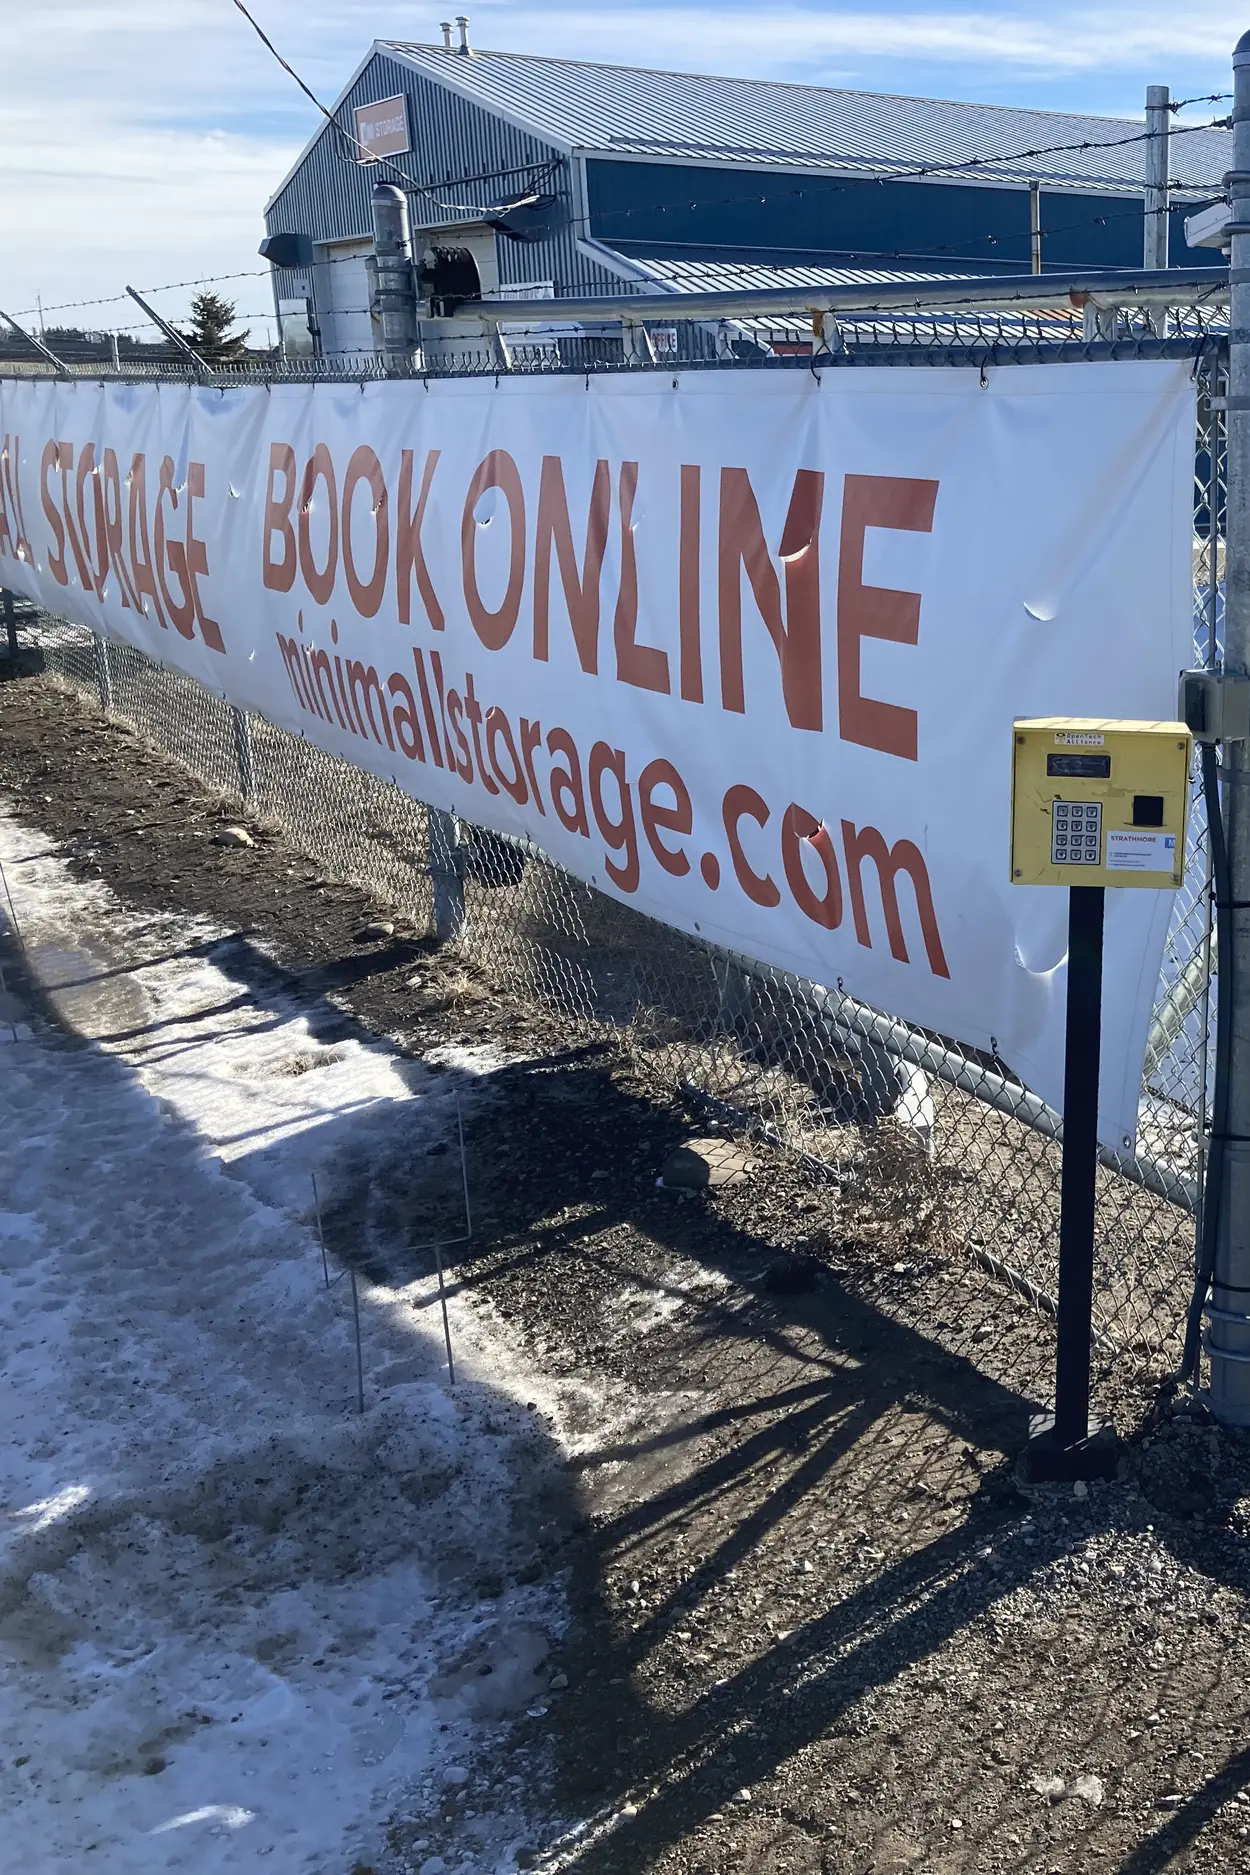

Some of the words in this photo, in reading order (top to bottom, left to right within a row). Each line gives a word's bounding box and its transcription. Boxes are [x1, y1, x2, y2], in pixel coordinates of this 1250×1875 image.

[41, 438, 227, 655] STORAGE
[262, 442, 445, 632] BOOK
[461, 449, 940, 763] ONLINE
[275, 610, 951, 980] minimallstorage.com
[1110, 835, 1157, 843] STRATHMORE
